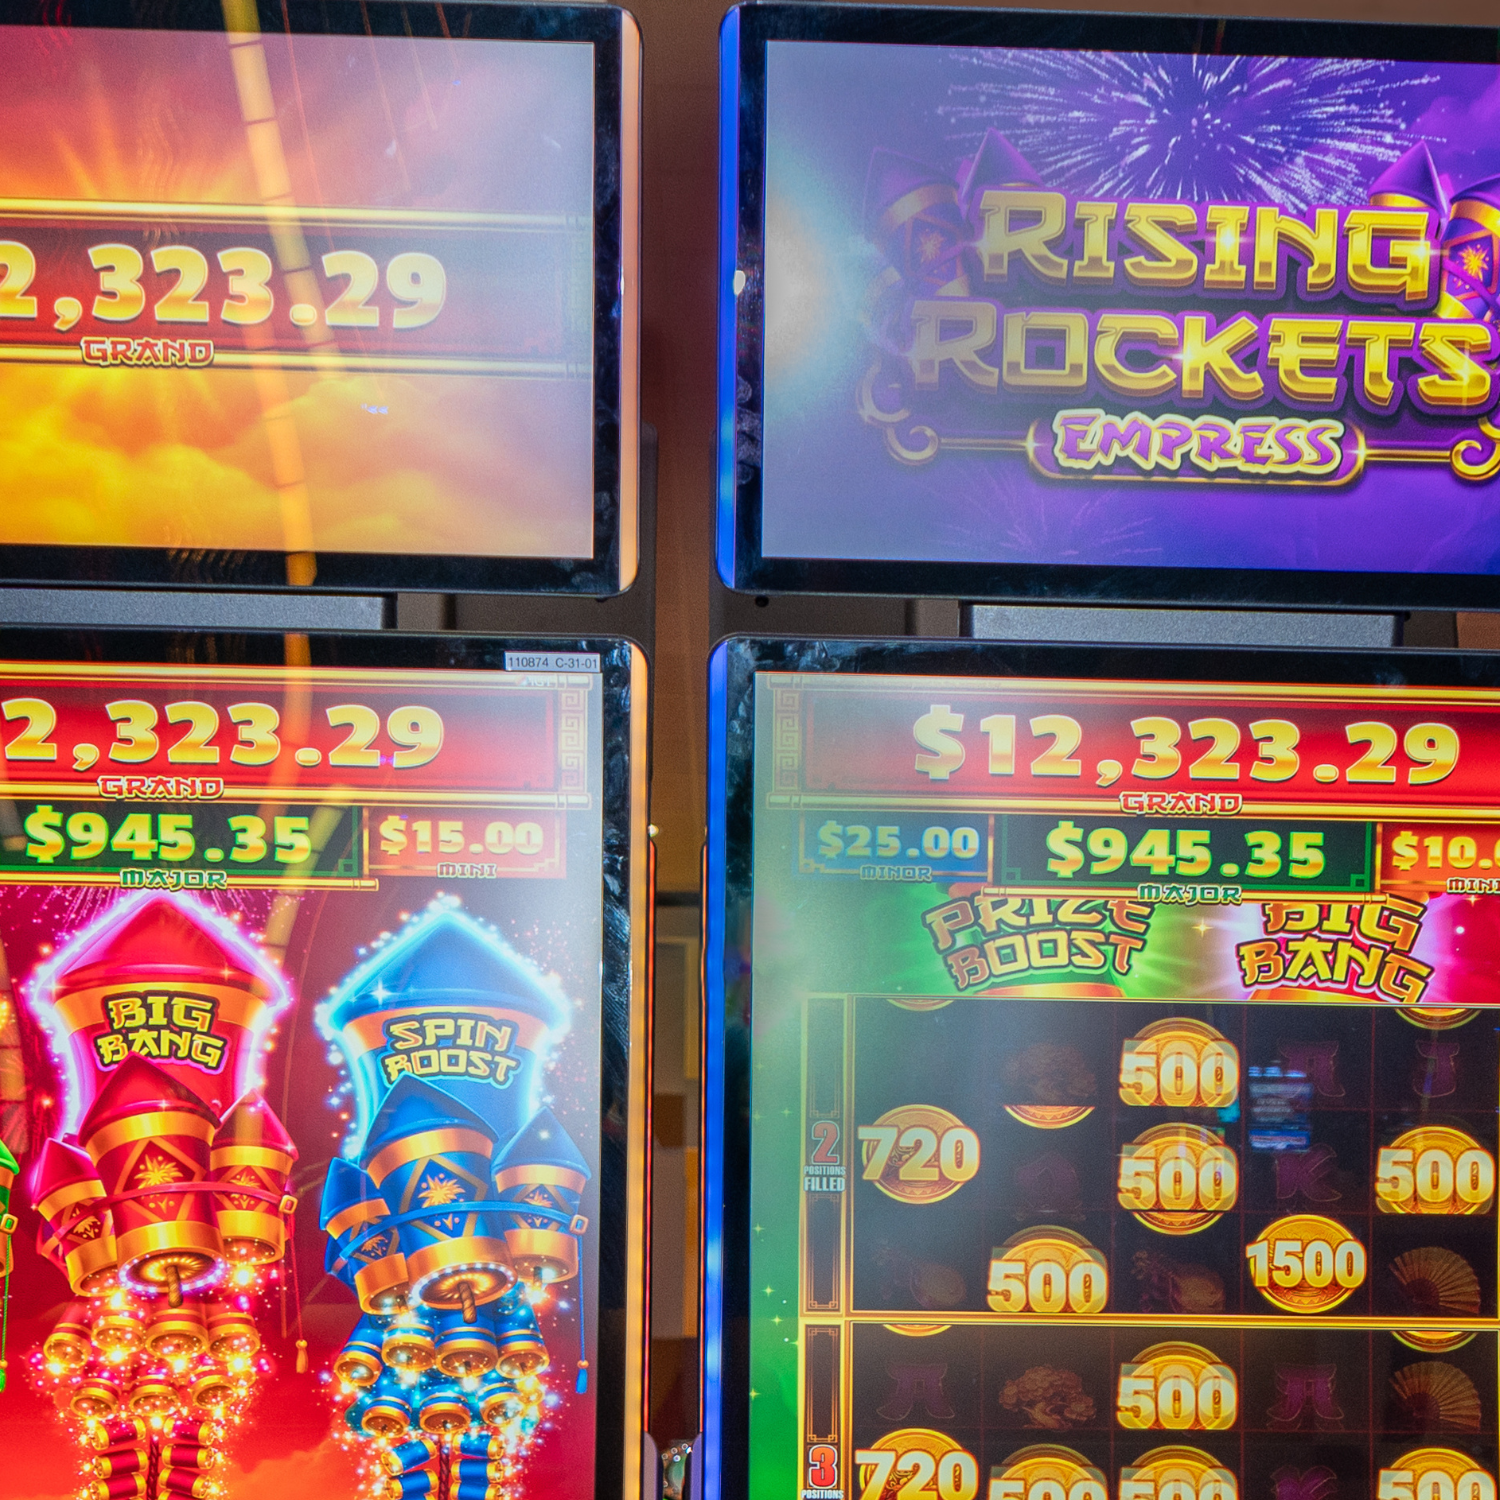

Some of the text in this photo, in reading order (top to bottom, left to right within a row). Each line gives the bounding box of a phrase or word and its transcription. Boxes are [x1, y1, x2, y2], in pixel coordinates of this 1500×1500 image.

[977, 190, 1431, 301] RISING
[81, 336, 214, 368] GRAND
[909, 301, 1495, 406] ROCKETS
[1053, 409, 1344, 474] EMPRESS
[508, 656, 597, 669] 110874 C-31-01
[913, 704, 1460, 788] $12,323.29
[99, 775, 225, 800] GRAND
[1120, 791, 1243, 816] GRAND
[25, 805, 313, 865] $945.35
[379, 816, 545, 857] $15.00
[817, 821, 980, 860] $25.00
[1046, 821, 1326, 880] $945.35
[1391, 830, 1500, 871] $10.
[121, 868, 229, 892] MAJOR
[437, 861, 498, 879] MINI
[860, 864, 933, 883] MINOR
[1137, 883, 1242, 906] MAJOR
[924, 896, 1152, 950] PRIZE
[1264, 893, 1427, 952] BIG
[946, 930, 1146, 989] BOOST
[1238, 935, 1435, 1002] BANG
[107, 996, 214, 1033] BIG
[389, 1018, 512, 1052] SPIN
[97, 1029, 224, 1069] BANG
[384, 1049, 518, 1083] BOOST
[1119, 1040, 1240, 1107] 500
[811, 1120, 840, 1165] 2
[857, 1126, 981, 1183] 720
[803, 1176, 846, 1192] FILLED
[1375, 1146, 1496, 1204] 500
[986, 1249, 1108, 1313] 500
[1247, 1240, 1367, 1289] 1500
[808, 1445, 838, 1489] 3
